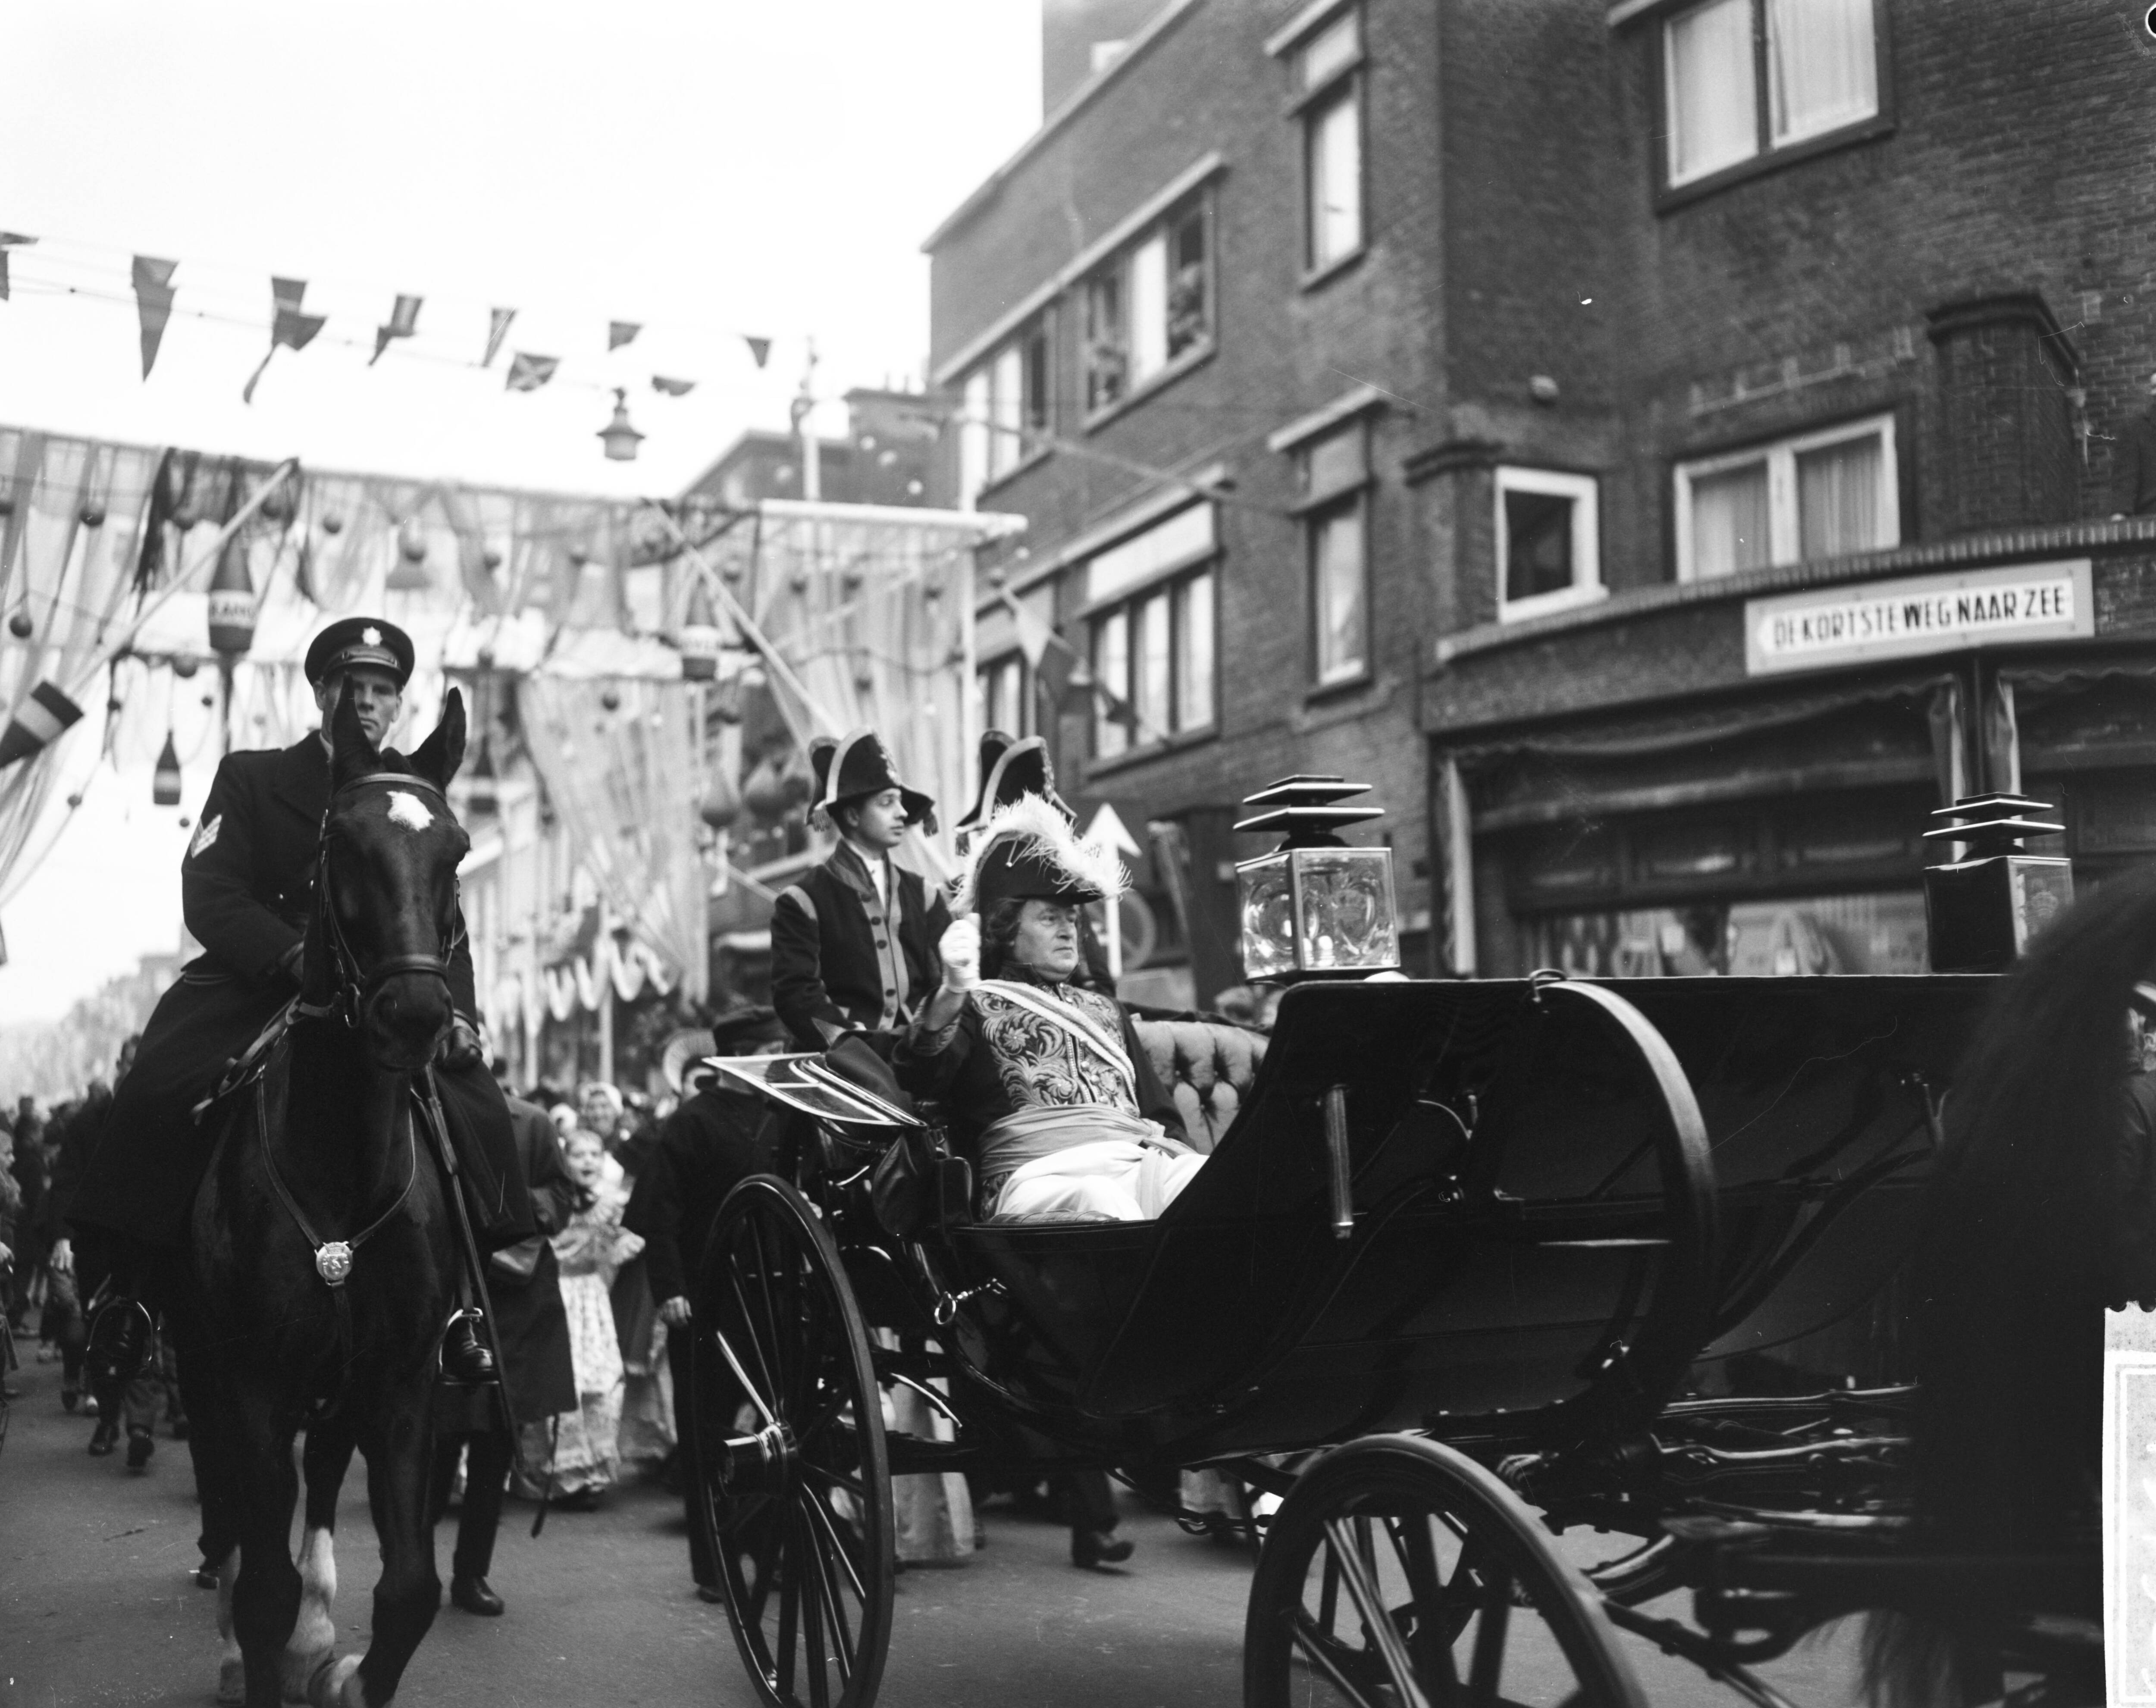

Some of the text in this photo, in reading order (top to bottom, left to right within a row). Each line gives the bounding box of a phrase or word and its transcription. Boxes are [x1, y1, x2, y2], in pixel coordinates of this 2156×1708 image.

[1774, 586, 2065, 647] DE KORTSTE WEG NAAR ZEE
